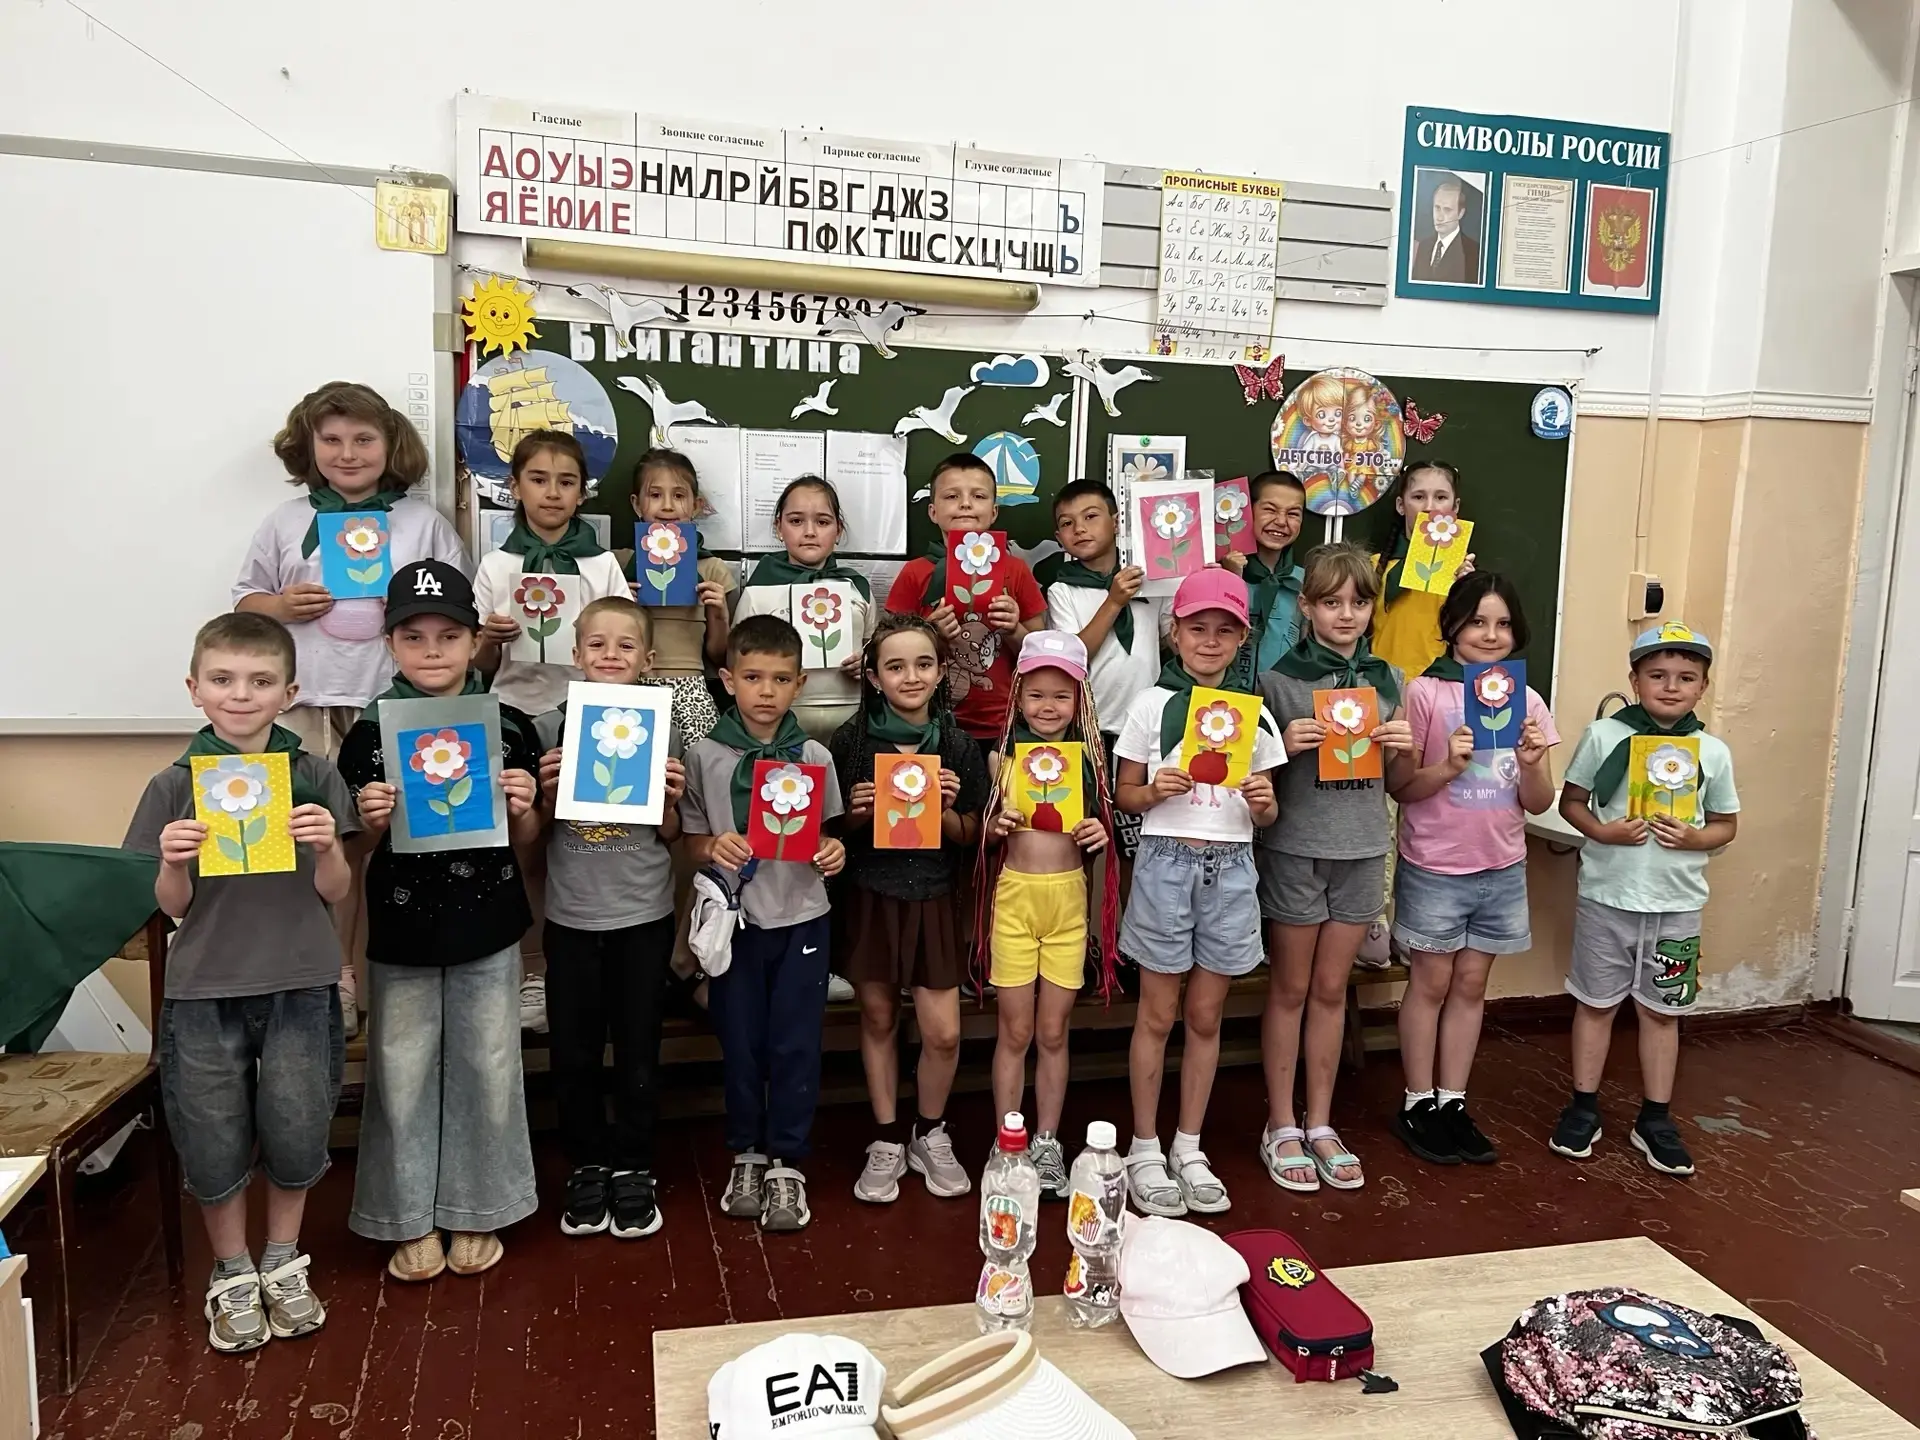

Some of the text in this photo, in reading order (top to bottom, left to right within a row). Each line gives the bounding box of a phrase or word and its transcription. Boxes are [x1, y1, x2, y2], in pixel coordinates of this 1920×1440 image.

[532, 111, 582, 128] Гласные
[659, 126, 765, 148] Звонкие согласные
[1416, 120, 1662, 171] СИМВОЛЫ РОССИИ
[823, 145, 921, 164] Парные согласные
[964, 159, 1053, 178] Глухие согласные
[1165, 175, 1280, 197] ПРОПИСНЫЕ БУКВЫ
[1527, 189, 1551, 197] ГИМН
[568, 322, 862, 375] Бригантина
[1278, 449, 1341, 465] ДЕТСТВО
[413, 568, 443, 596] LA
[766, 1362, 858, 1417] EA7
[771, 1404, 867, 1430] EMPORIO ARMANI
